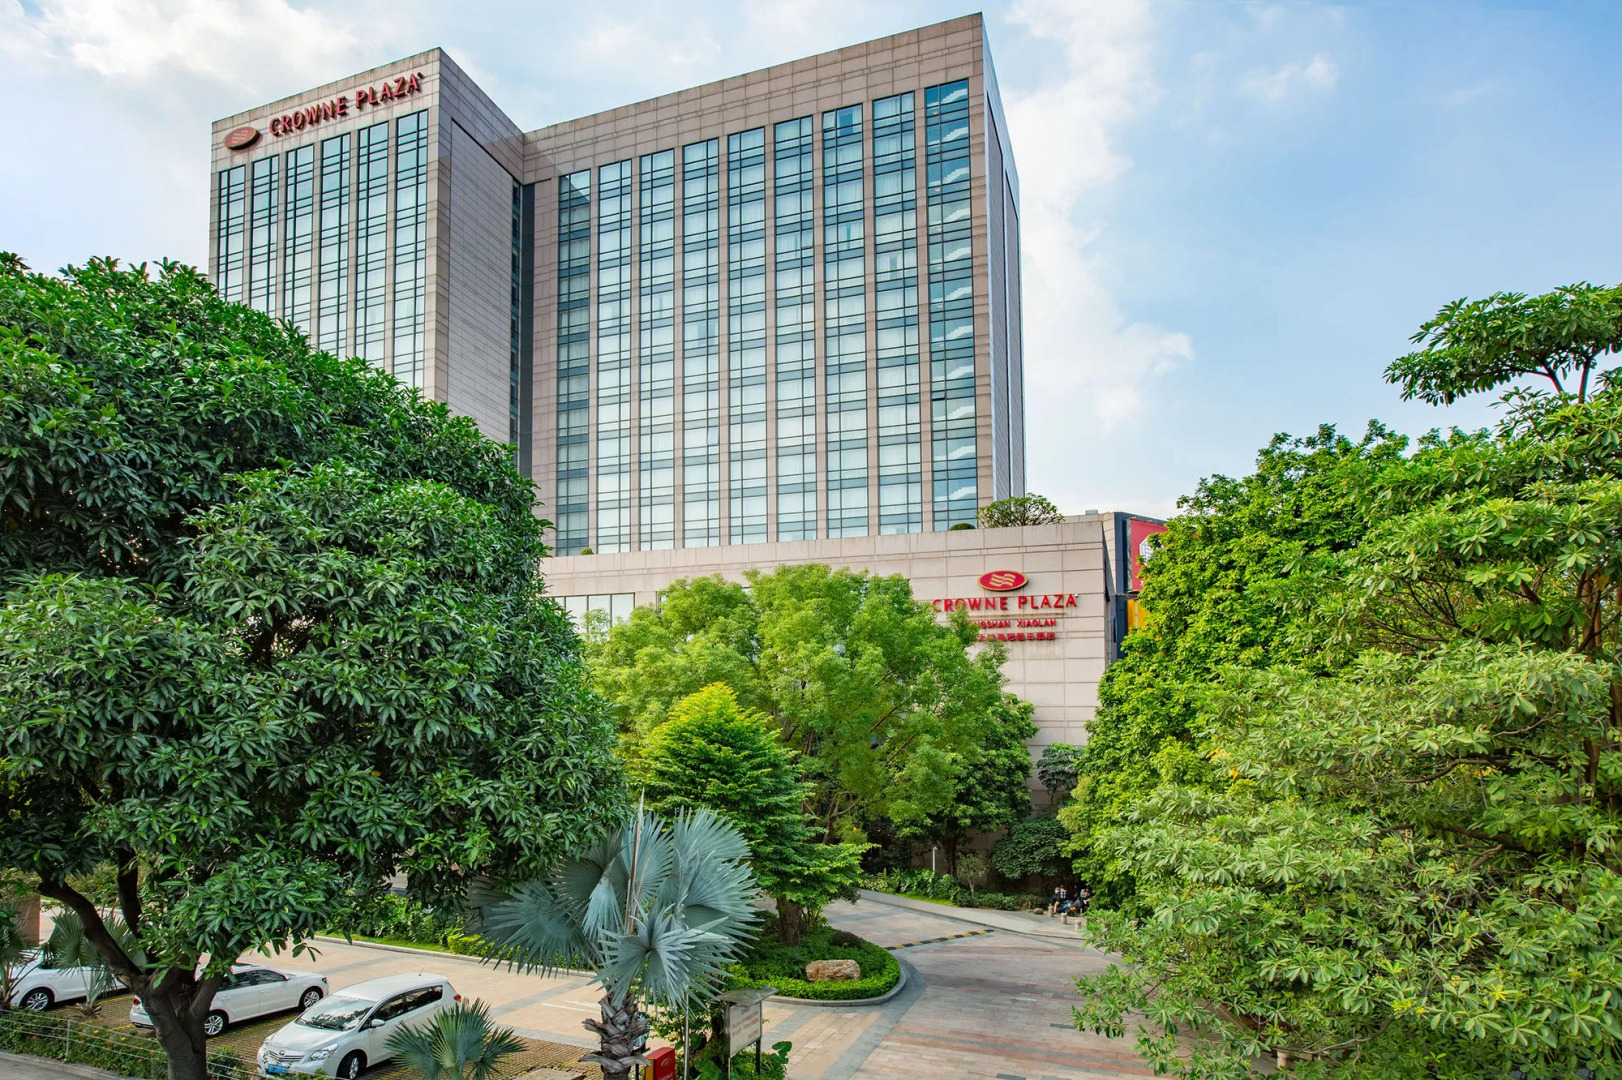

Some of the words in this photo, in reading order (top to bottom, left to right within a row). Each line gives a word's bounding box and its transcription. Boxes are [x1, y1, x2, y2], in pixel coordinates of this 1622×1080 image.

[269, 96, 347, 136] CROWNE
[355, 73, 419, 109] PLAZA
[932, 596, 1008, 613] CROWNE
[1018, 593, 1077, 610] PLAZA
[1017, 618, 1057, 628] XIAOLAN
